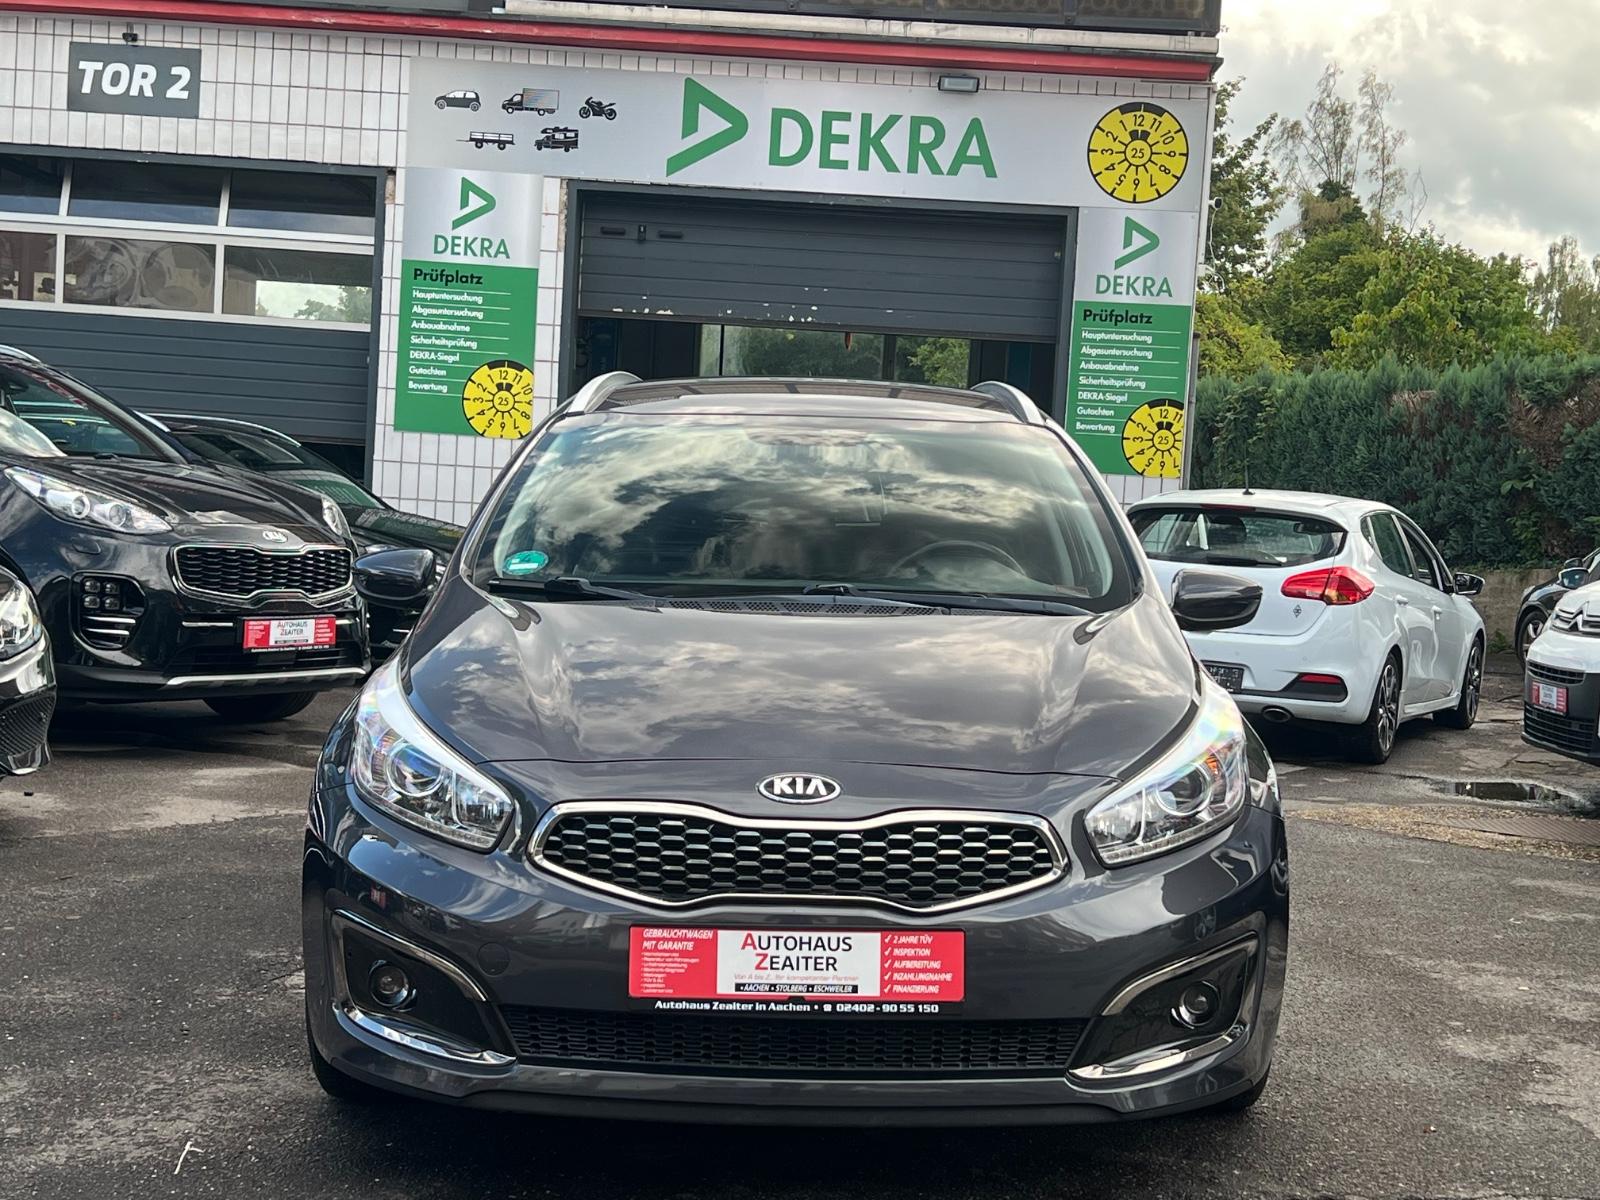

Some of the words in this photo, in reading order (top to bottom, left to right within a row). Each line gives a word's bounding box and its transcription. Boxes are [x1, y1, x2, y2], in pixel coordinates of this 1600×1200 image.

[78, 60, 158, 98] TOR
[165, 65, 191, 99] 2
[1119, 120, 1128, 132] 1
[1133, 114, 1145, 127] 12
[768, 107, 998, 178] DEKRA
[1105, 131, 1119, 142] 2
[1160, 130, 1175, 145] 10
[1131, 148, 1145, 159] 25
[1104, 163, 1116, 171] 4
[1158, 164, 1171, 175] 8
[1115, 174, 1126, 186] 5
[1149, 174, 1157, 187] 7
[433, 234, 510, 259] DEKRA
[413, 268, 483, 286] Prüfplatz
[1095, 274, 1173, 298] DEKRA
[412, 289, 483, 304] Hauptuntersuchung
[411, 305, 484, 320] Abgasuntersuchung
[1083, 309, 1153, 326] Prüfplatz
[410, 320, 470, 332] Anbauabnahme
[410, 335, 478, 349] Sicherheitsprüfung
[1081, 330, 1153, 344] Hauptuntersuchung
[410, 350, 460, 363] DEKRA-Siegel
[1080, 345, 1153, 359] Abgasuntersuchung
[409, 365, 447, 376] Gutachten
[1079, 360, 1139, 372] Anbauabnahme
[498, 370, 509, 381] 12
[408, 381, 448, 393] Bewertung
[1078, 376, 1146, 390] Sicherheitsprüfung
[498, 397, 509, 406] 25
[1078, 391, 1128, 403] DEKRA-Siegel
[1076, 406, 1114, 417] Gutachten
[1159, 408, 1169, 419] 12
[1075, 421, 1115, 433] Bewertung
[1157, 435, 1169, 445] 25
[773, 777, 828, 796] KIA
[642, 928, 714, 939] GEBRAUCHTWAGEN
[893, 935, 899, 944] 2
[898, 935, 919, 944] JAHRE
[919, 934, 933, 944] TÜV
[642, 940, 656, 950] MIT
[657, 941, 695, 950] GARANTIE
[741, 932, 853, 952] AUTOHAUS
[893, 948, 931, 956] INSPEKTION
[755, 953, 838, 972] ZEAITER
[893, 960, 942, 969] AUFBEREITUNG
[775, 984, 807, 992] STOLBERG
[892, 984, 940, 994] FINANZIERUNG
[654, 1000, 711, 1010] Autohaus
[768, 1002, 810, 1012] Aachen
[836, 1003, 875, 1013] 02402
[899, 1004, 915, 1013] 55
[918, 1004, 939, 1013] 150
